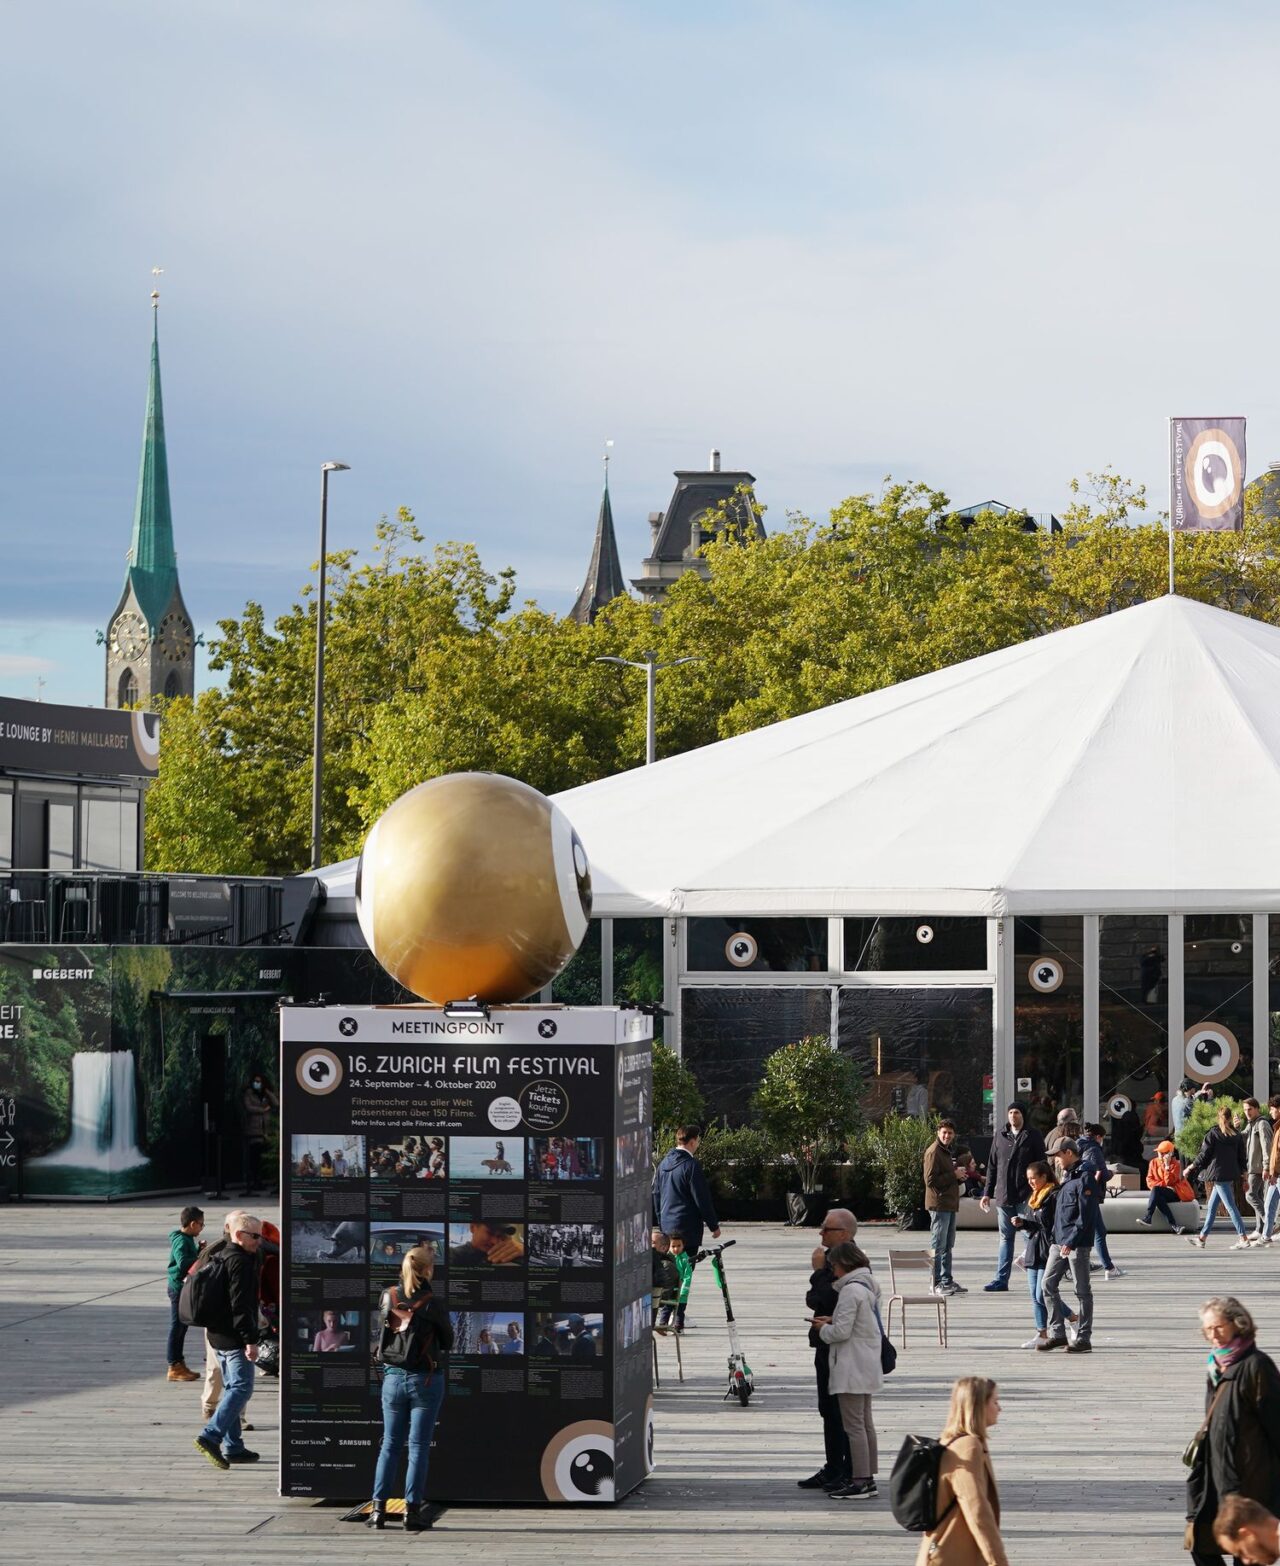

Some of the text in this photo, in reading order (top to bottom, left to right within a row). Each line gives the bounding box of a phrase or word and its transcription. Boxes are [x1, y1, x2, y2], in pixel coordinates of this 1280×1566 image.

[6, 723, 40, 742] LOUNGE
[42, 728, 52, 743] BY
[54, 729, 79, 745] HENRI
[81, 732, 129, 749] MAILLARDET
[43, 969, 95, 980] GEBERIT
[0, 1005, 25, 1019] EIT
[392, 1021, 504, 1034] MEETINGPOINT
[348, 1055, 600, 1075] 16. ZURICH FILM FESTIVAL
[350, 1080, 363, 1088] 24.
[365, 1080, 414, 1090] September
[424, 1081, 433, 1089] 4.
[435, 1080, 473, 1089] Oktober
[475, 1081, 497, 1089] 2020
[534, 1084, 556, 1095] Jetzt
[352, 1097, 473, 1107] Filmemacher aus aller Welt
[528, 1092, 561, 1105] Tickets
[352, 1108, 477, 1118] präsentieren über 150 Filme.
[528, 1101, 558, 1113] kaufen
